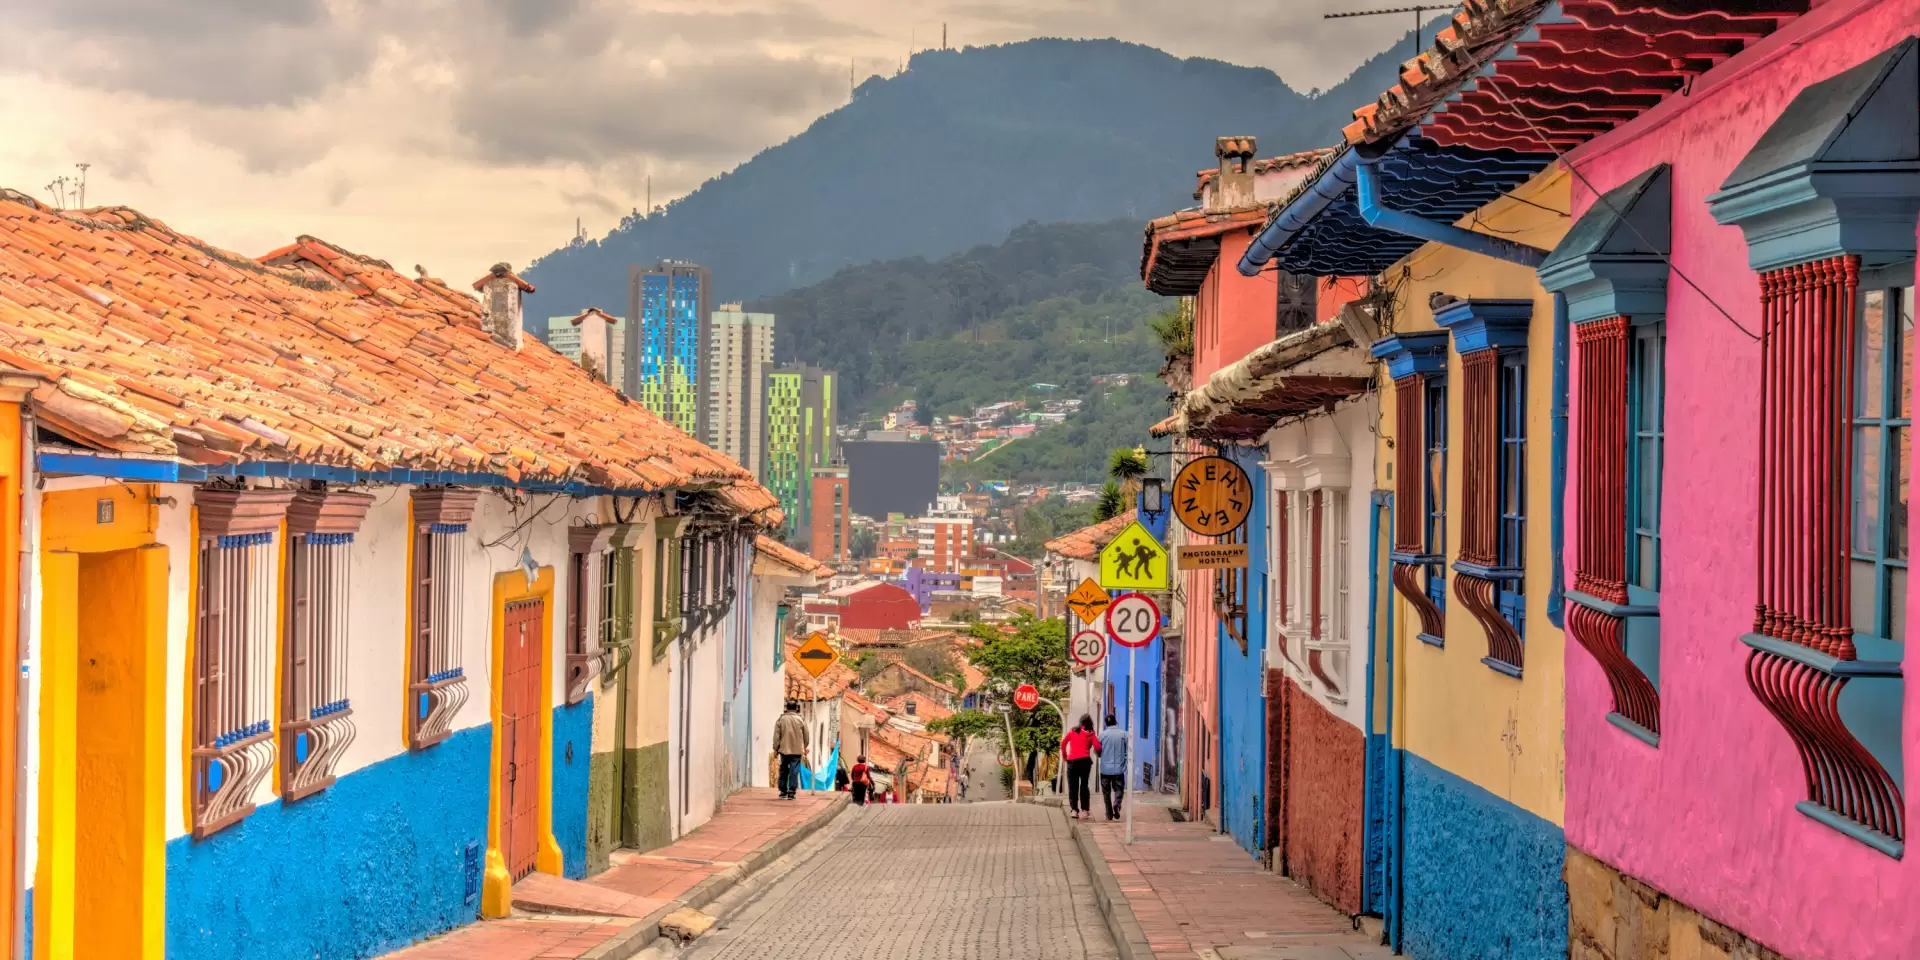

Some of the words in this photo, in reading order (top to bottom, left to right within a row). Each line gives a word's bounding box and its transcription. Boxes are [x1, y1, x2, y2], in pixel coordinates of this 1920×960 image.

[1183, 549, 1244, 558] PHOTOGRAPHY
[1117, 607, 1150, 633] 20
[1077, 640, 1099, 656] 20
[1016, 691, 1036, 703] PARE
